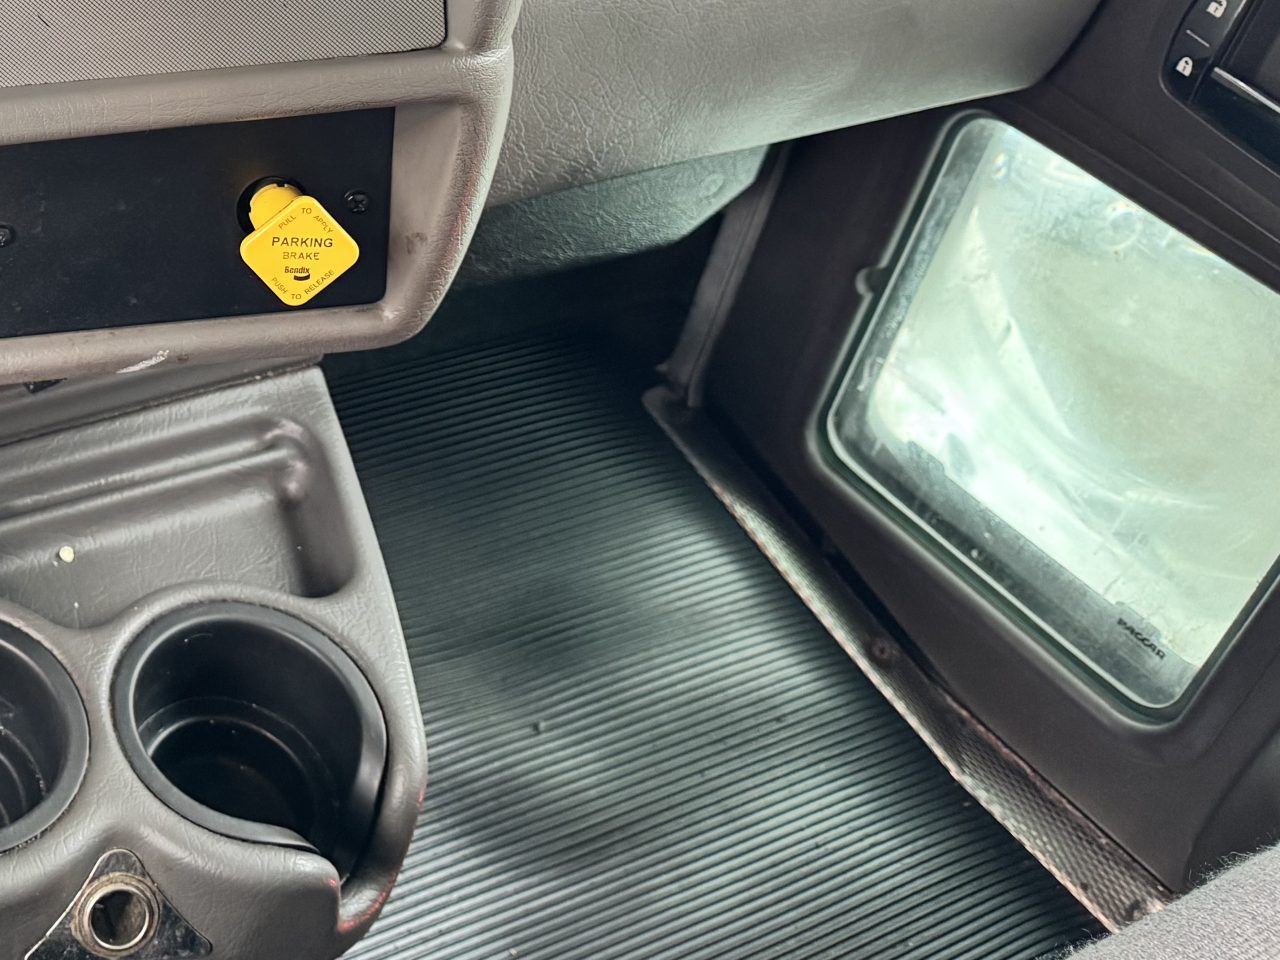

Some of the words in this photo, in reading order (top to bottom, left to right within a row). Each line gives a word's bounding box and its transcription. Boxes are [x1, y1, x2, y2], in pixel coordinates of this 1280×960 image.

[278, 215, 296, 230] PULL
[313, 215, 334, 234] APPLY
[272, 236, 333, 248] PARKING
[283, 251, 320, 260] BRAKE
[285, 266, 310, 274] Bendix
[272, 277, 288, 294] PUSH
[304, 270, 334, 294] RELEASE
